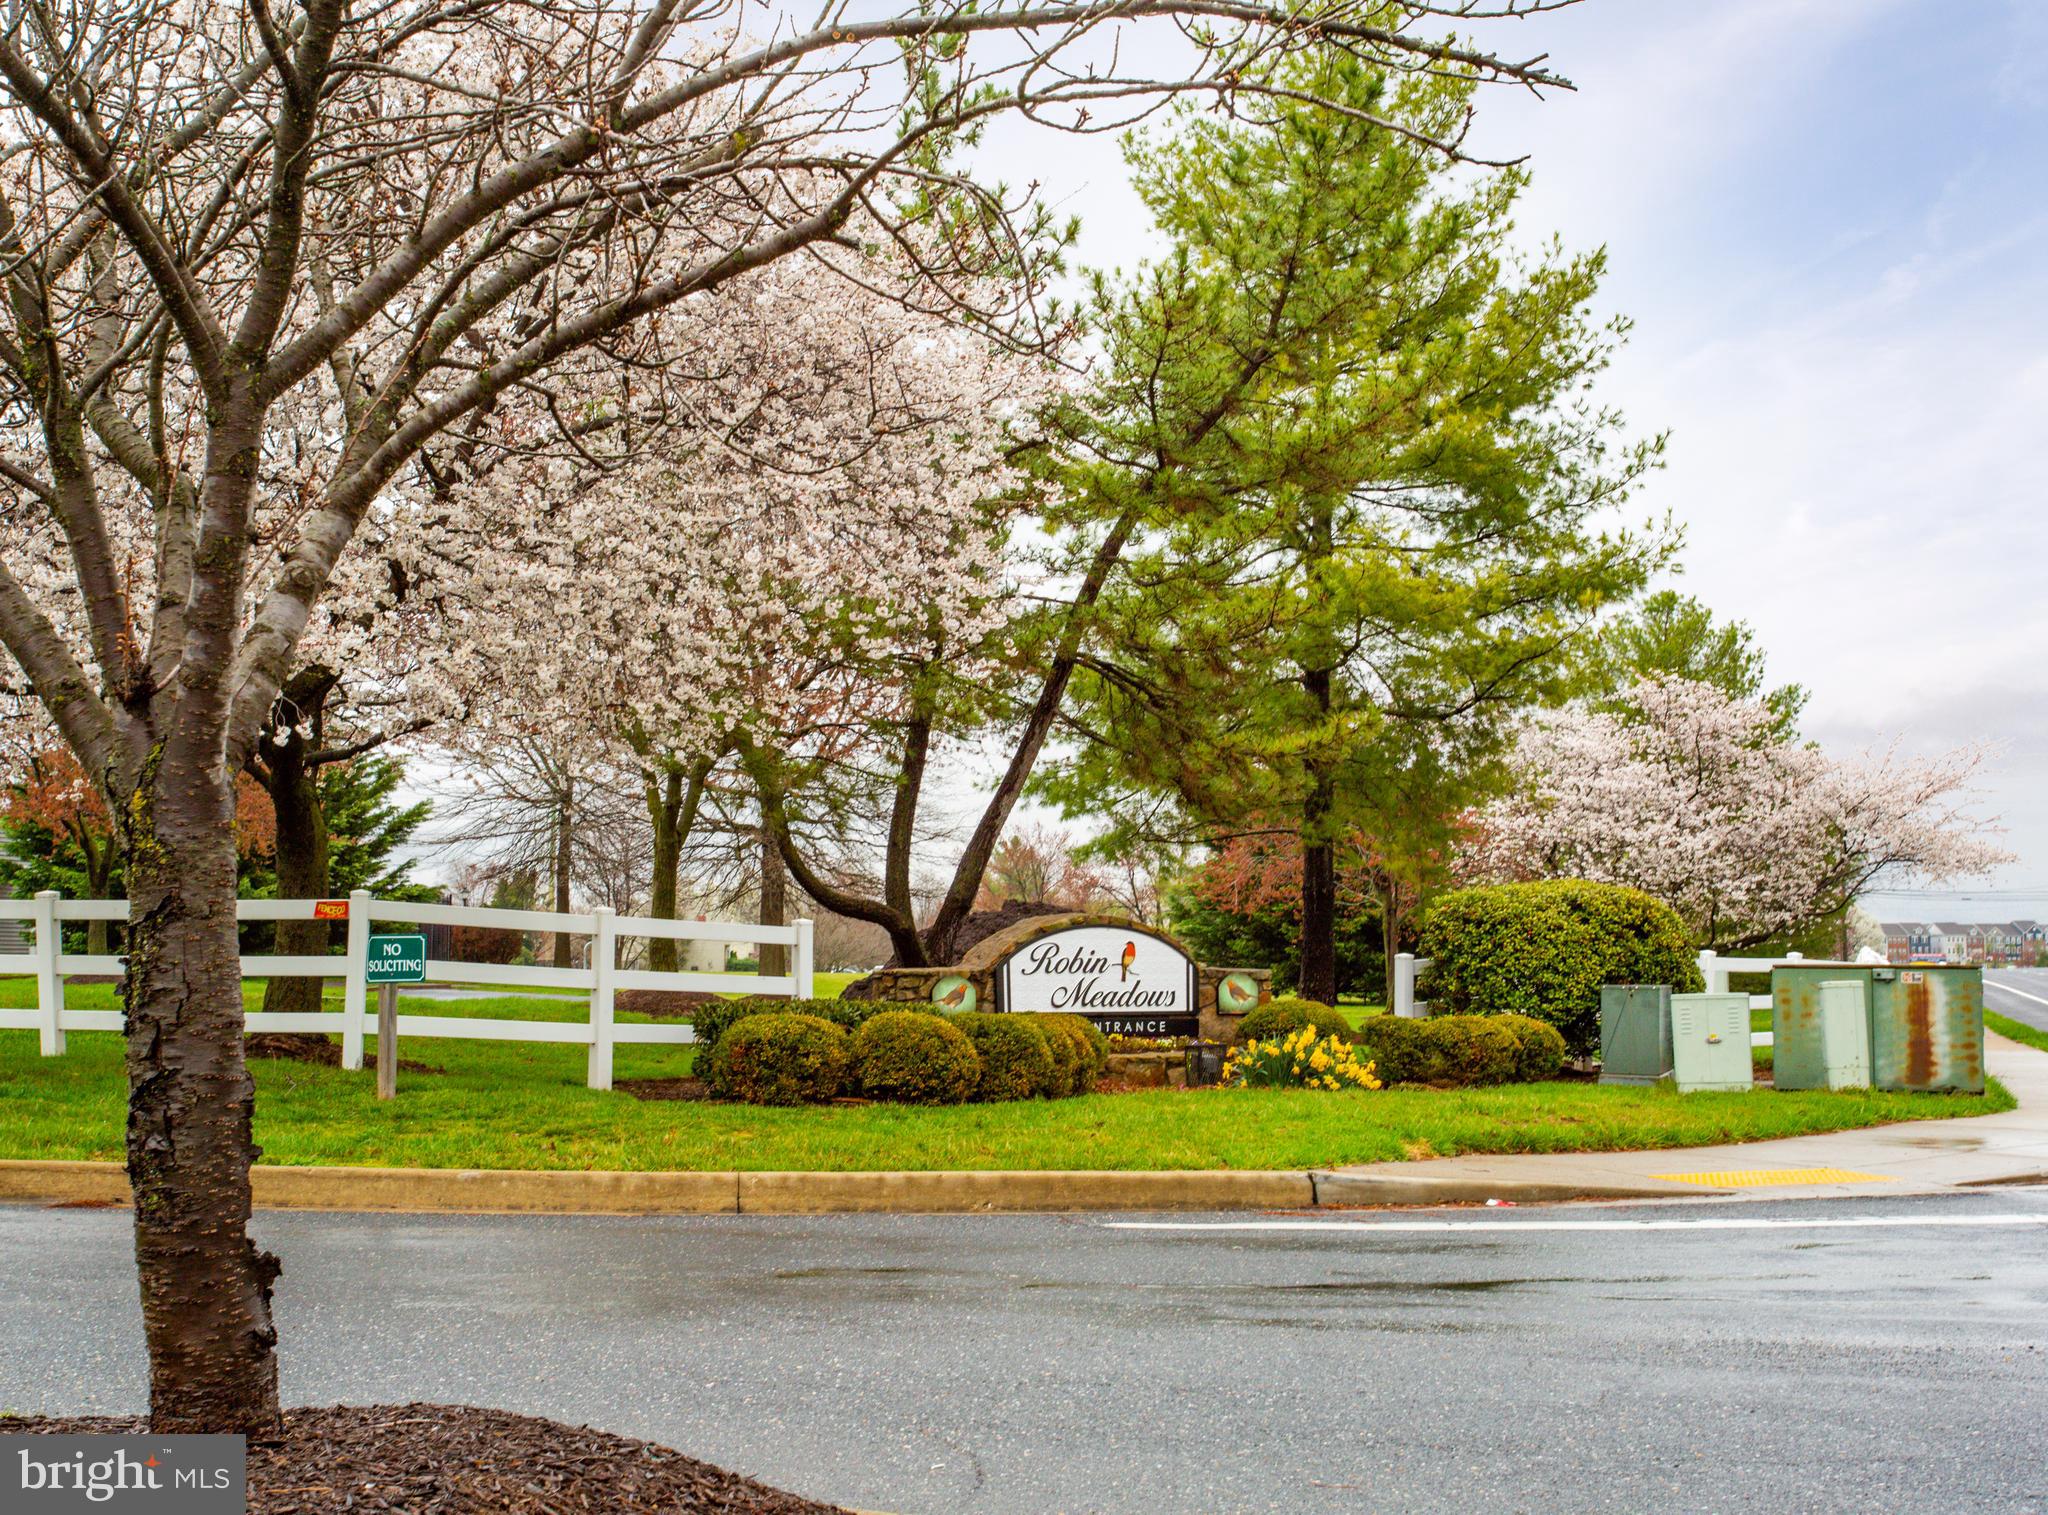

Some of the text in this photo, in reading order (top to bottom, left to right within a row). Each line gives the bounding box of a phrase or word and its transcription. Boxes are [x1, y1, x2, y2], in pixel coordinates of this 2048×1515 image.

[383, 944, 401, 956] NO
[1021, 942, 1110, 976] Robin
[368, 960, 421, 972] SOLICITING
[1050, 976, 1176, 1008] Meadows
[1093, 1021, 1166, 1032] NTRANCE
